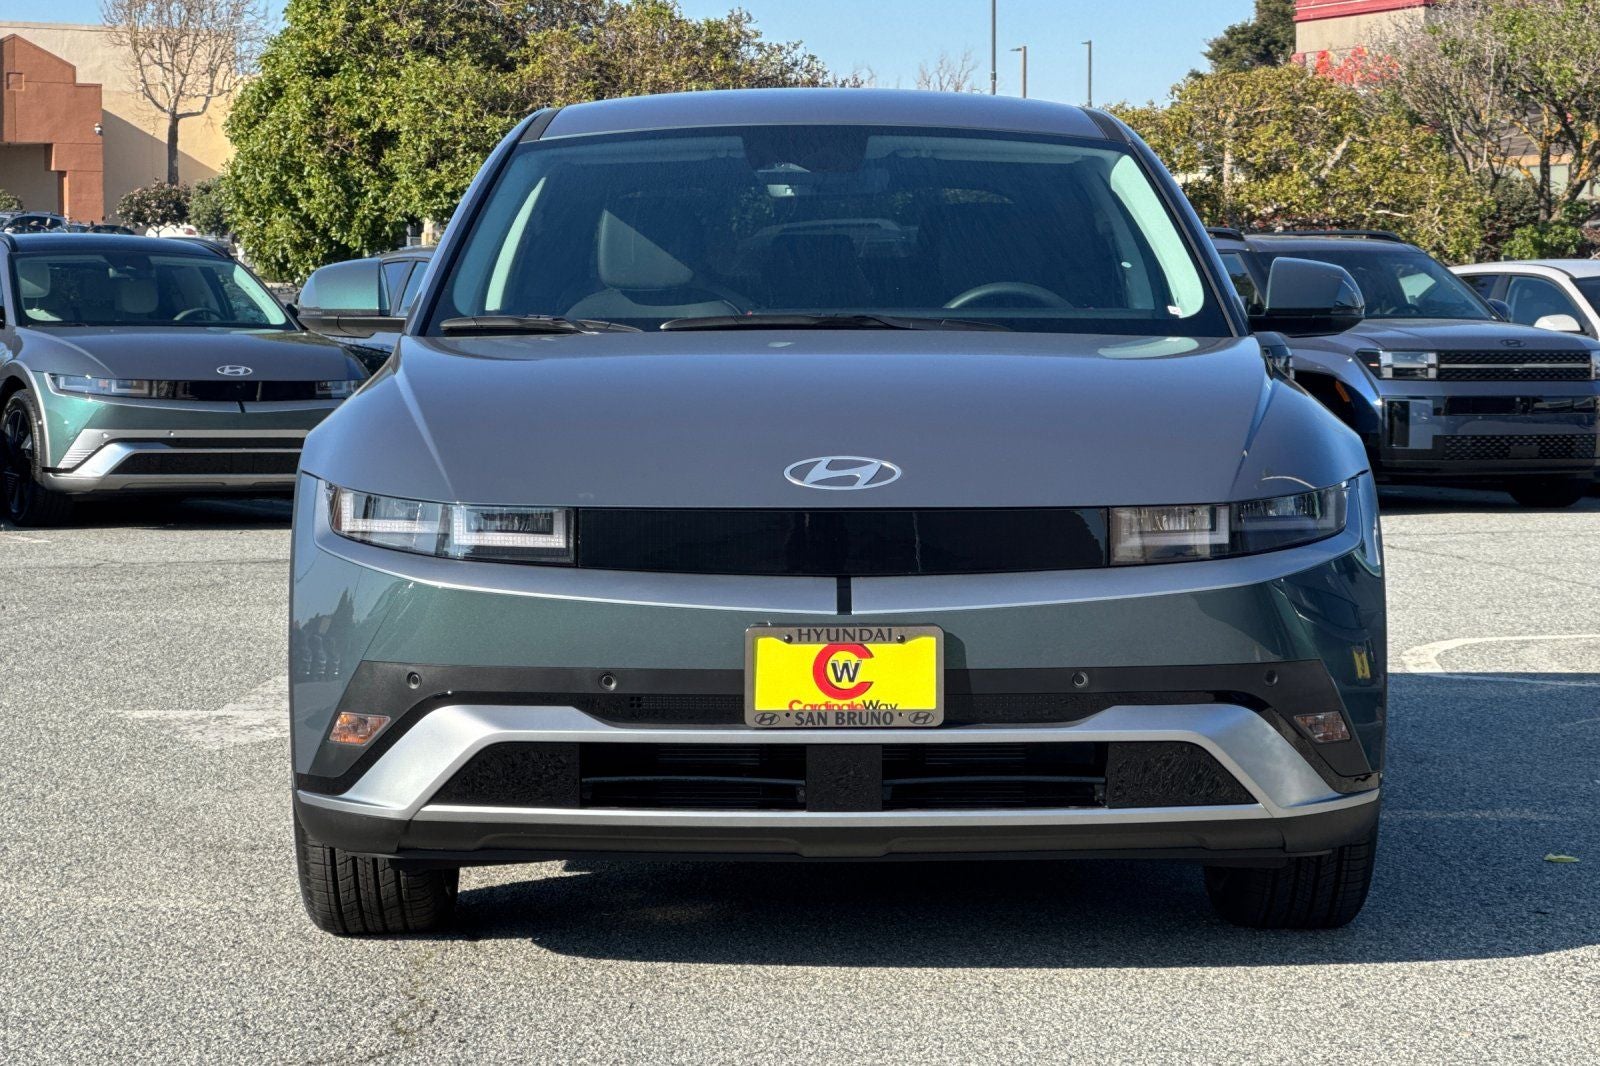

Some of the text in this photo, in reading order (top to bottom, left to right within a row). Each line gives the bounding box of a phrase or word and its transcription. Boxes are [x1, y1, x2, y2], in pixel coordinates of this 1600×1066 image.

[797, 628, 892, 642] HYUNDAI
[795, 711, 894, 726] SAN BRUNO
